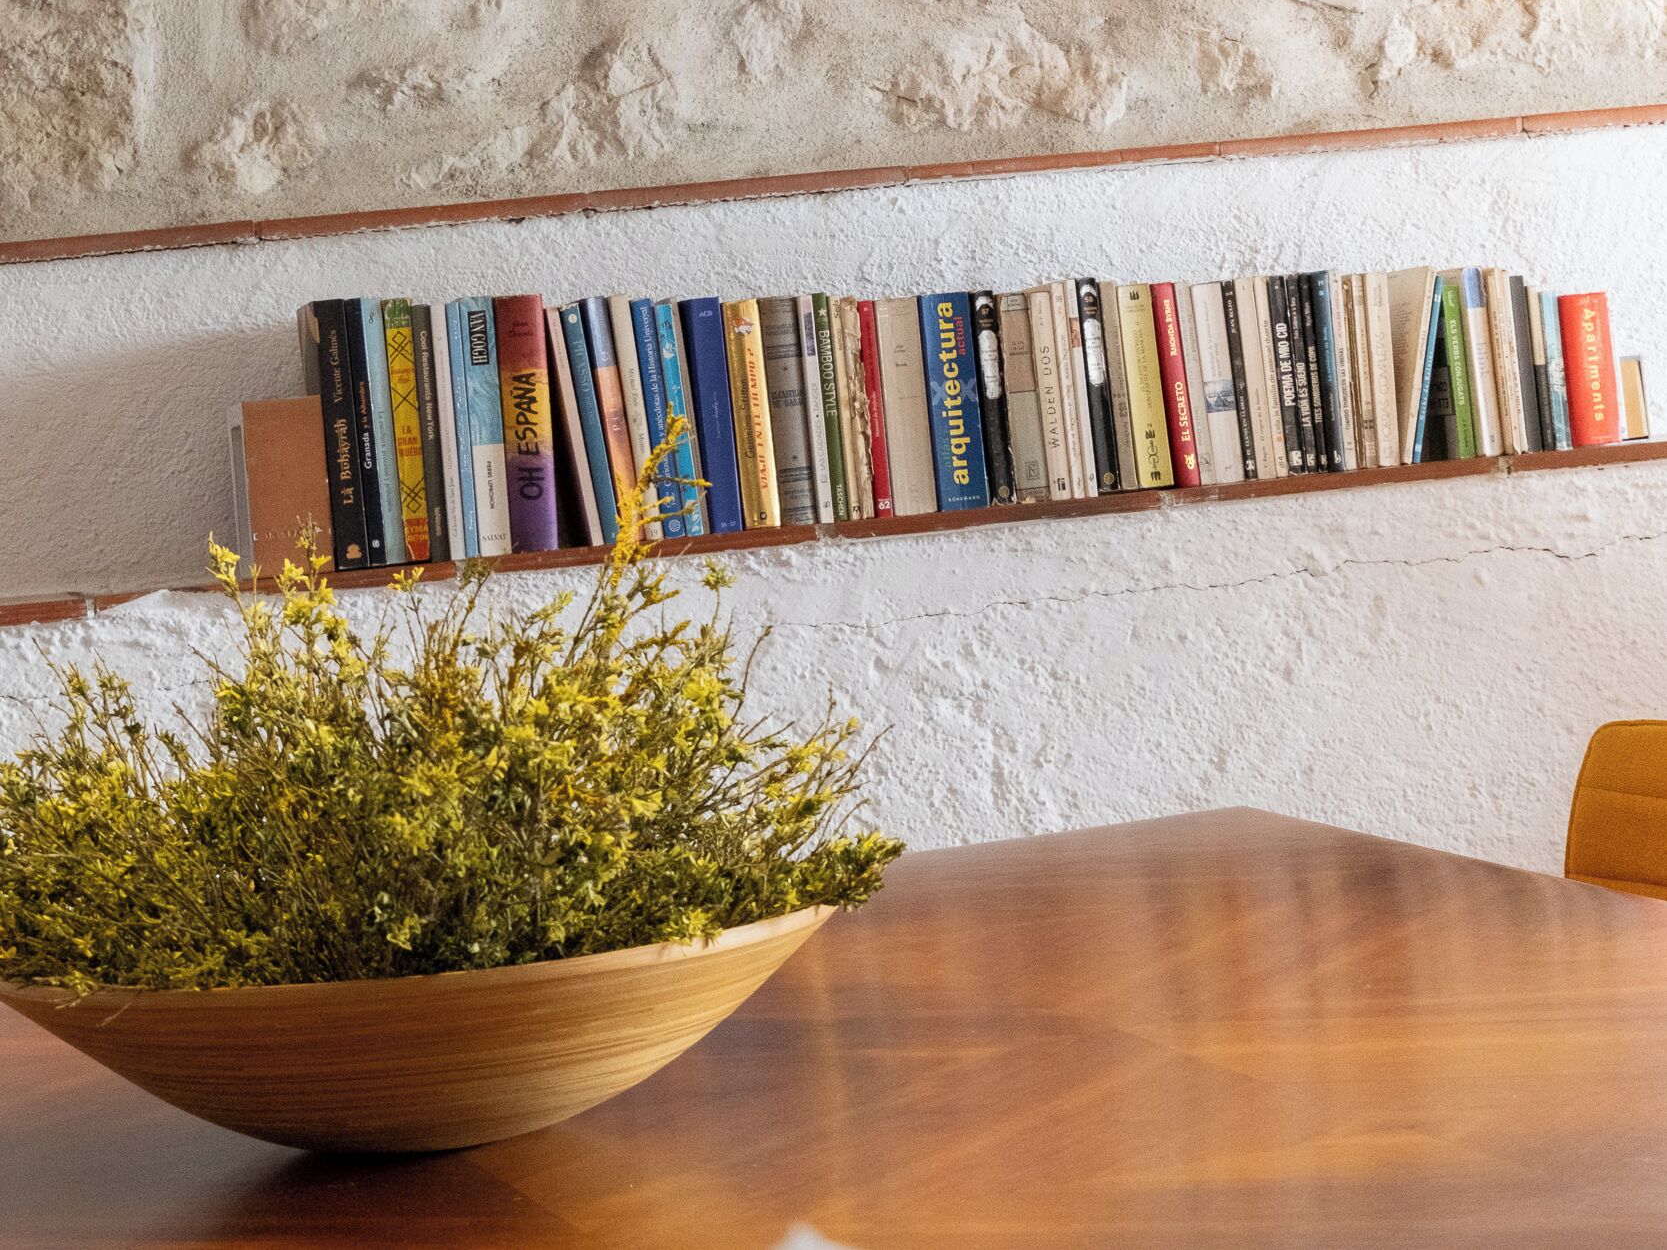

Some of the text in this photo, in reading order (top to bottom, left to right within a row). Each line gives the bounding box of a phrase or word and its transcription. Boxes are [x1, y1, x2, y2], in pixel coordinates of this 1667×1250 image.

[641, 307, 652, 343] Universal
[833, 300, 841, 320] Seda
[420, 330, 428, 350] Cool
[470, 311, 488, 364] VAN GOGH
[954, 317, 966, 356] actual
[1163, 299, 1178, 356] RHONDA BYRNE
[1263, 319, 1271, 344] duarte
[329, 329, 344, 403] Vicente Galmés
[572, 339, 591, 391] PICASSO
[646, 343, 657, 374] Historia
[818, 329, 837, 417] BAMBOO STYLE
[1264, 345, 1276, 373] pascual
[1275, 322, 1296, 407] POEMA DE MIO CID
[1375, 333, 1388, 394] COMPLETAS
[1449, 319, 1465, 406] ELS VERBS CONJUGATS
[1582, 308, 1606, 421] Apartments
[422, 352, 433, 400] Restaurants
[651, 374, 658, 382] la
[652, 383, 659, 393] de
[747, 361, 761, 409] TIEMPO
[1268, 373, 1276, 383] de
[1297, 388, 1308, 397] ES
[1308, 345, 1323, 424] TRES SOMBREROS DE COPA
[359, 381, 367, 415] Alhambra
[936, 302, 971, 485] arquitectura
[1040, 345, 1061, 449] WALDEN DOS
[1175, 382, 1189, 428] SECRETO
[1239, 396, 1247, 417] LLAMAS
[1270, 384, 1279, 409] familia
[1299, 399, 1310, 414] VIDA
[1341, 379, 1349, 408] ENMUDECEN
[510, 372, 541, 457] ESPAÑA
[653, 394, 666, 431] anécdotas
[739, 379, 756, 459] Geronimo Stilton
[754, 414, 762, 428] EL
[1301, 415, 1312, 427] LA
[1342, 410, 1351, 431] CUANDO
[398, 435, 418, 446] GRAN
[402, 425, 412, 435] LA
[427, 421, 435, 440] York
[757, 431, 764, 448] EN
[815, 419, 825, 457] CIUDADES
[1181, 428, 1191, 442] EL
[362, 432, 372, 469] Granada
[818, 459, 826, 470] LAS
[519, 467, 545, 500] OH
[836, 483, 844, 516] TASCHEN
[878, 500, 891, 510] 62
[482, 534, 508, 542] SALVAT
